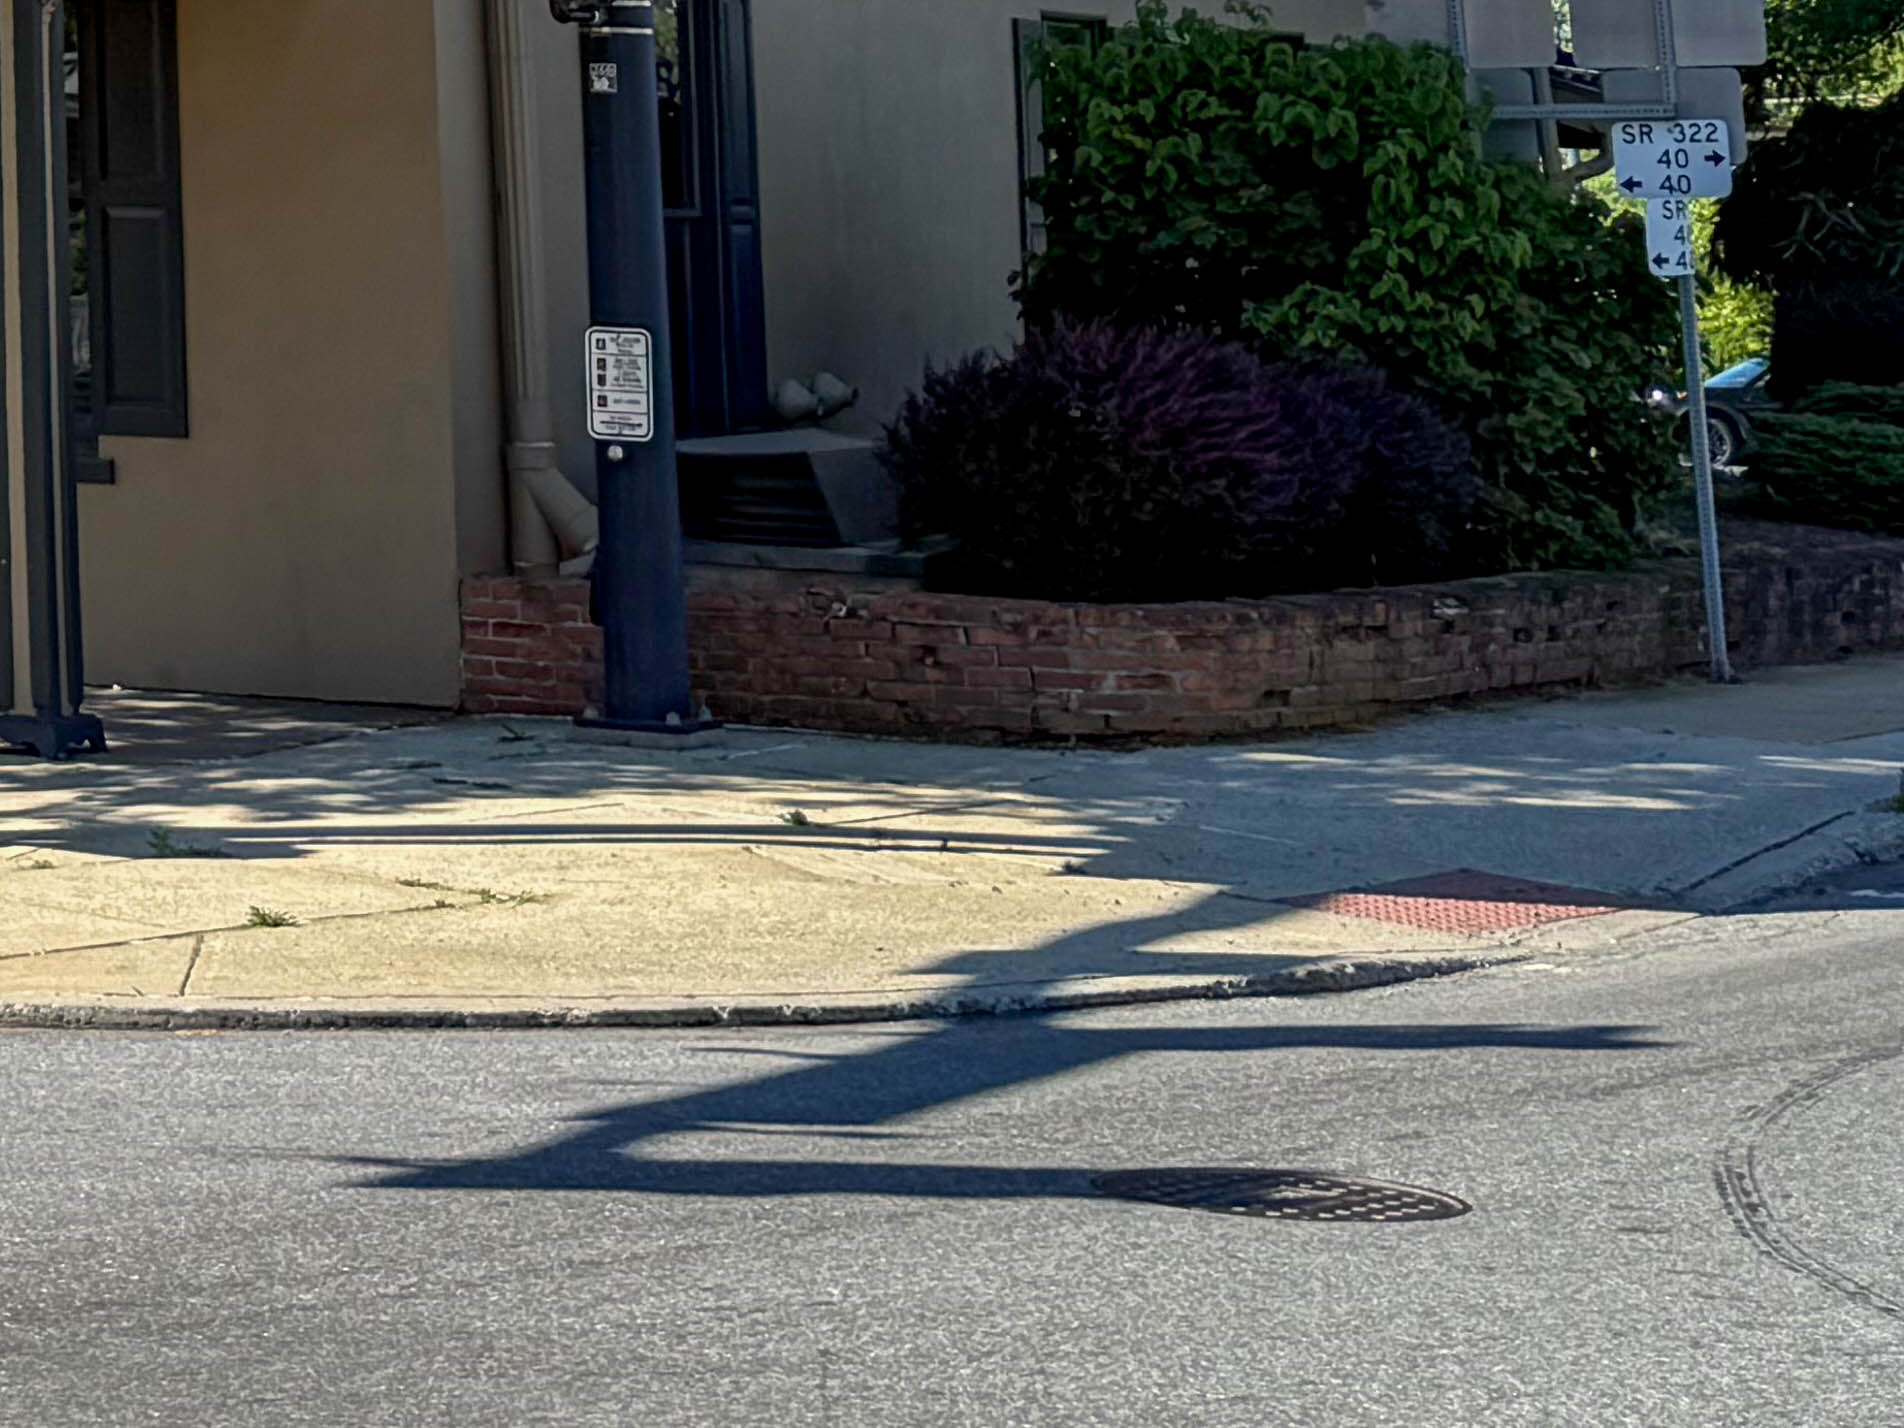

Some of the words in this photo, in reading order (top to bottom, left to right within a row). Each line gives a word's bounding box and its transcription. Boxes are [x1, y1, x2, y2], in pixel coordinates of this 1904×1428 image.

[1621, 123, 1653, 144] SR
[1672, 122, 1719, 143] 322
[1657, 148, 1689, 169] 40
[1659, 174, 1691, 195] 40
